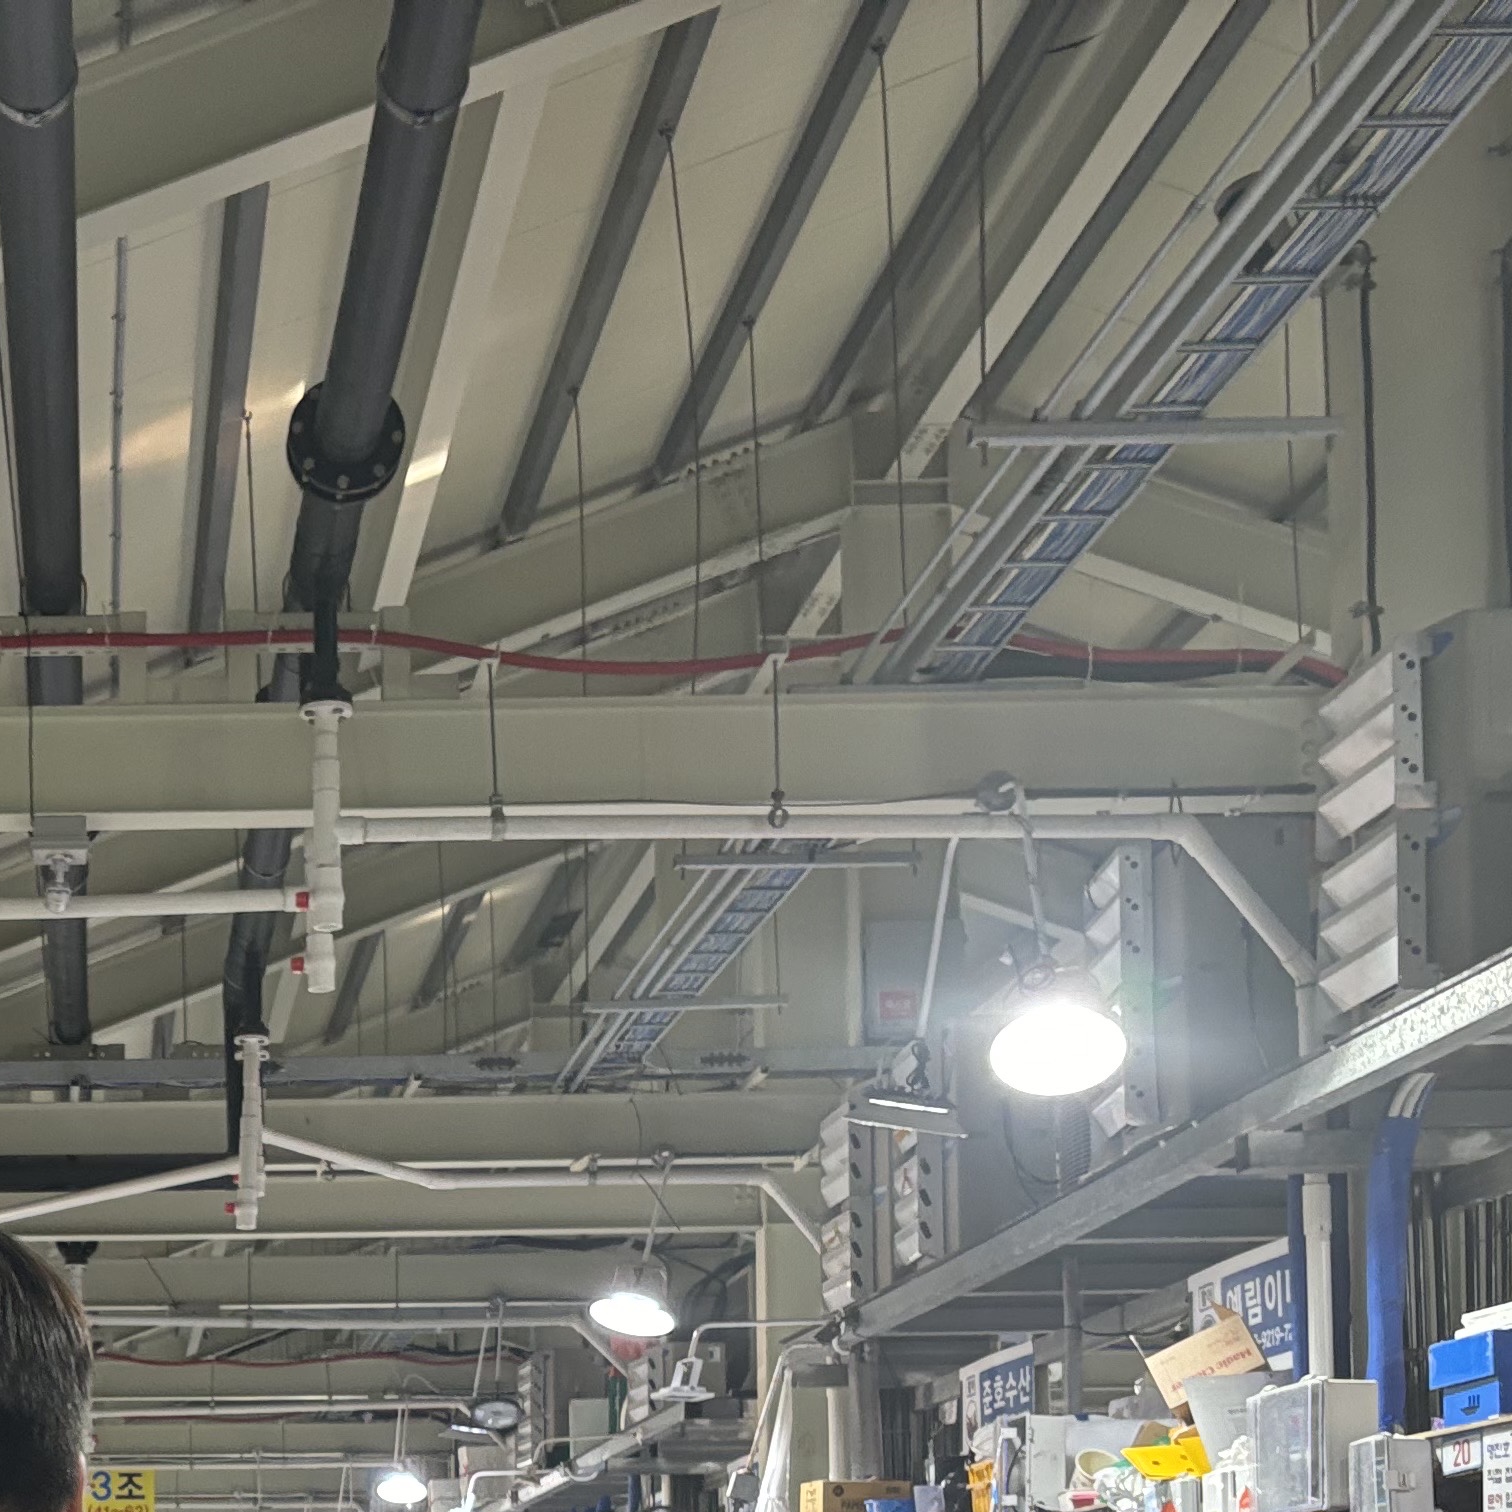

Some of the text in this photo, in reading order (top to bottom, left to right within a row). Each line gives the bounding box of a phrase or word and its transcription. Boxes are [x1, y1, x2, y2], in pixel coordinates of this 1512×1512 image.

[1226, 1269, 1292, 1327] 예림이
[982, 1365, 1031, 1416] 준호수산
[1452, 1438, 1471, 1468] 20
[91, 1471, 146, 1501] 3조
